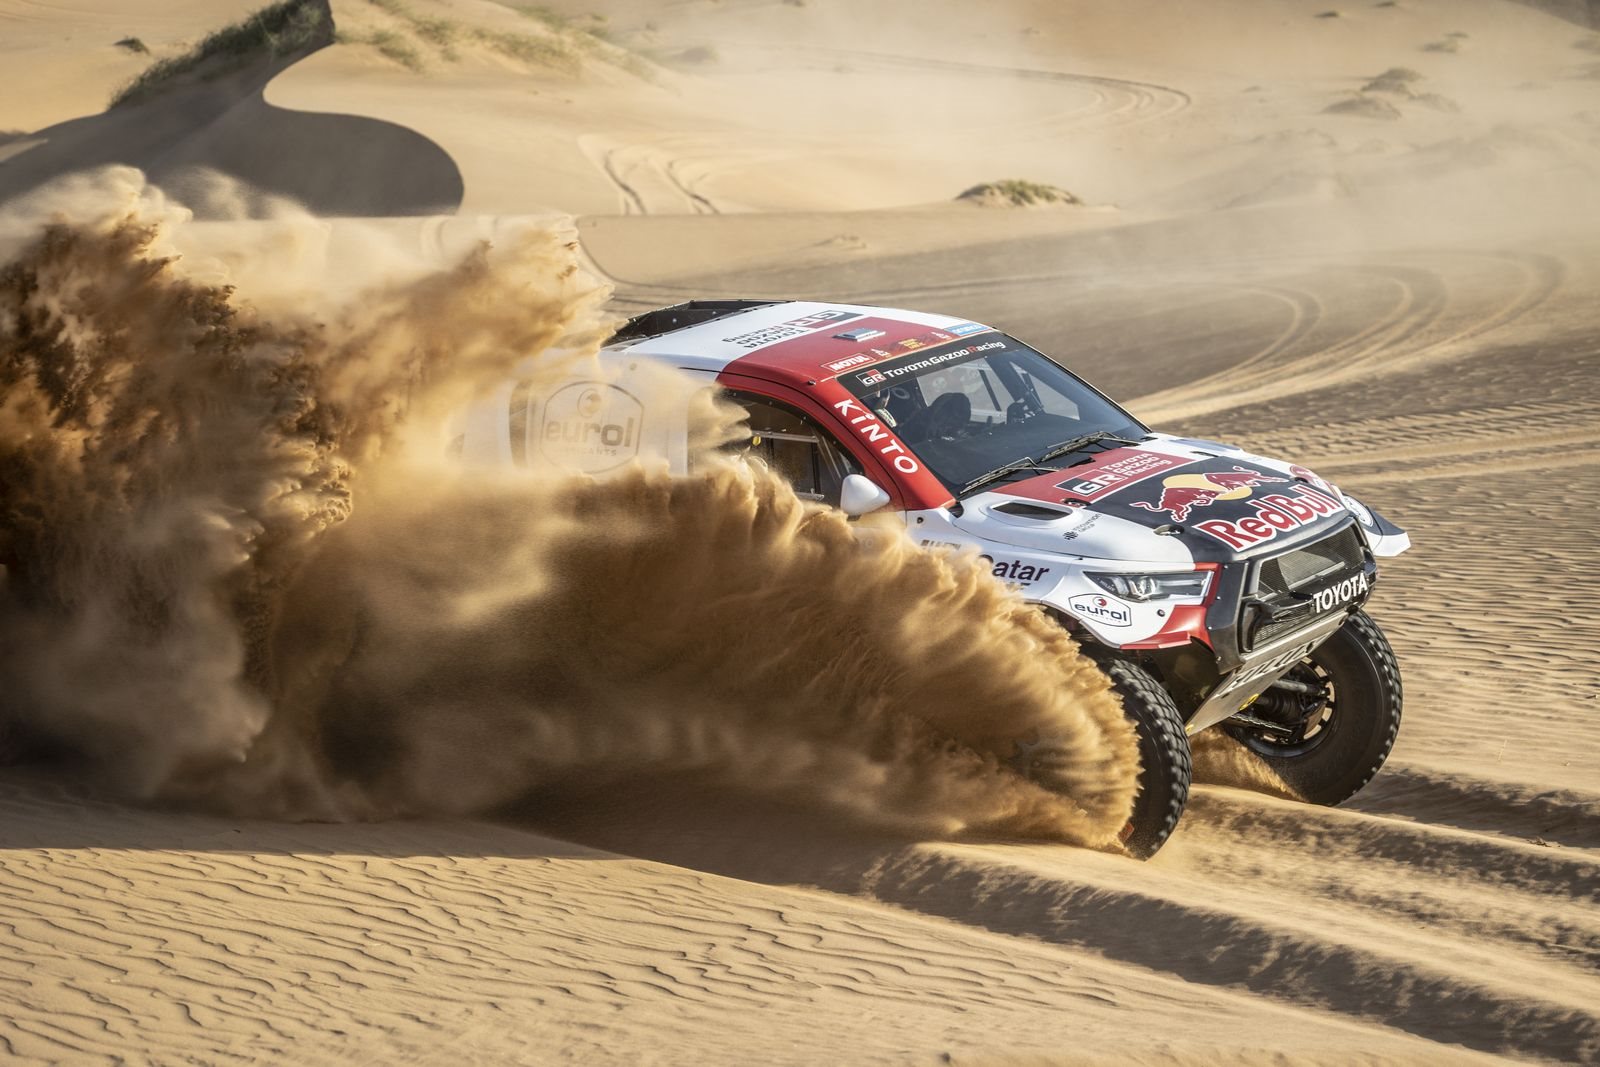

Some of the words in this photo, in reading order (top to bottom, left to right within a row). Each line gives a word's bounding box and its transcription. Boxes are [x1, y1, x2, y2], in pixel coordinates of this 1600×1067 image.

[737, 327, 796, 345] GAZOO
[744, 329, 809, 348] TOYOTA
[829, 355, 871, 371] MOTUL
[862, 373, 887, 386] GR
[883, 360, 932, 378] TOYOTA
[929, 348, 970, 365] GAZOO
[967, 340, 1007, 354] Racing
[545, 417, 635, 448] eurol
[1100, 453, 1153, 472] TOYOTA
[1113, 456, 1161, 475] GAZOO
[1123, 459, 1173, 479] Racing
[1072, 474, 1126, 496] GR
[1312, 572, 1370, 614] TOYOTA
[1074, 603, 1127, 622] eurol
